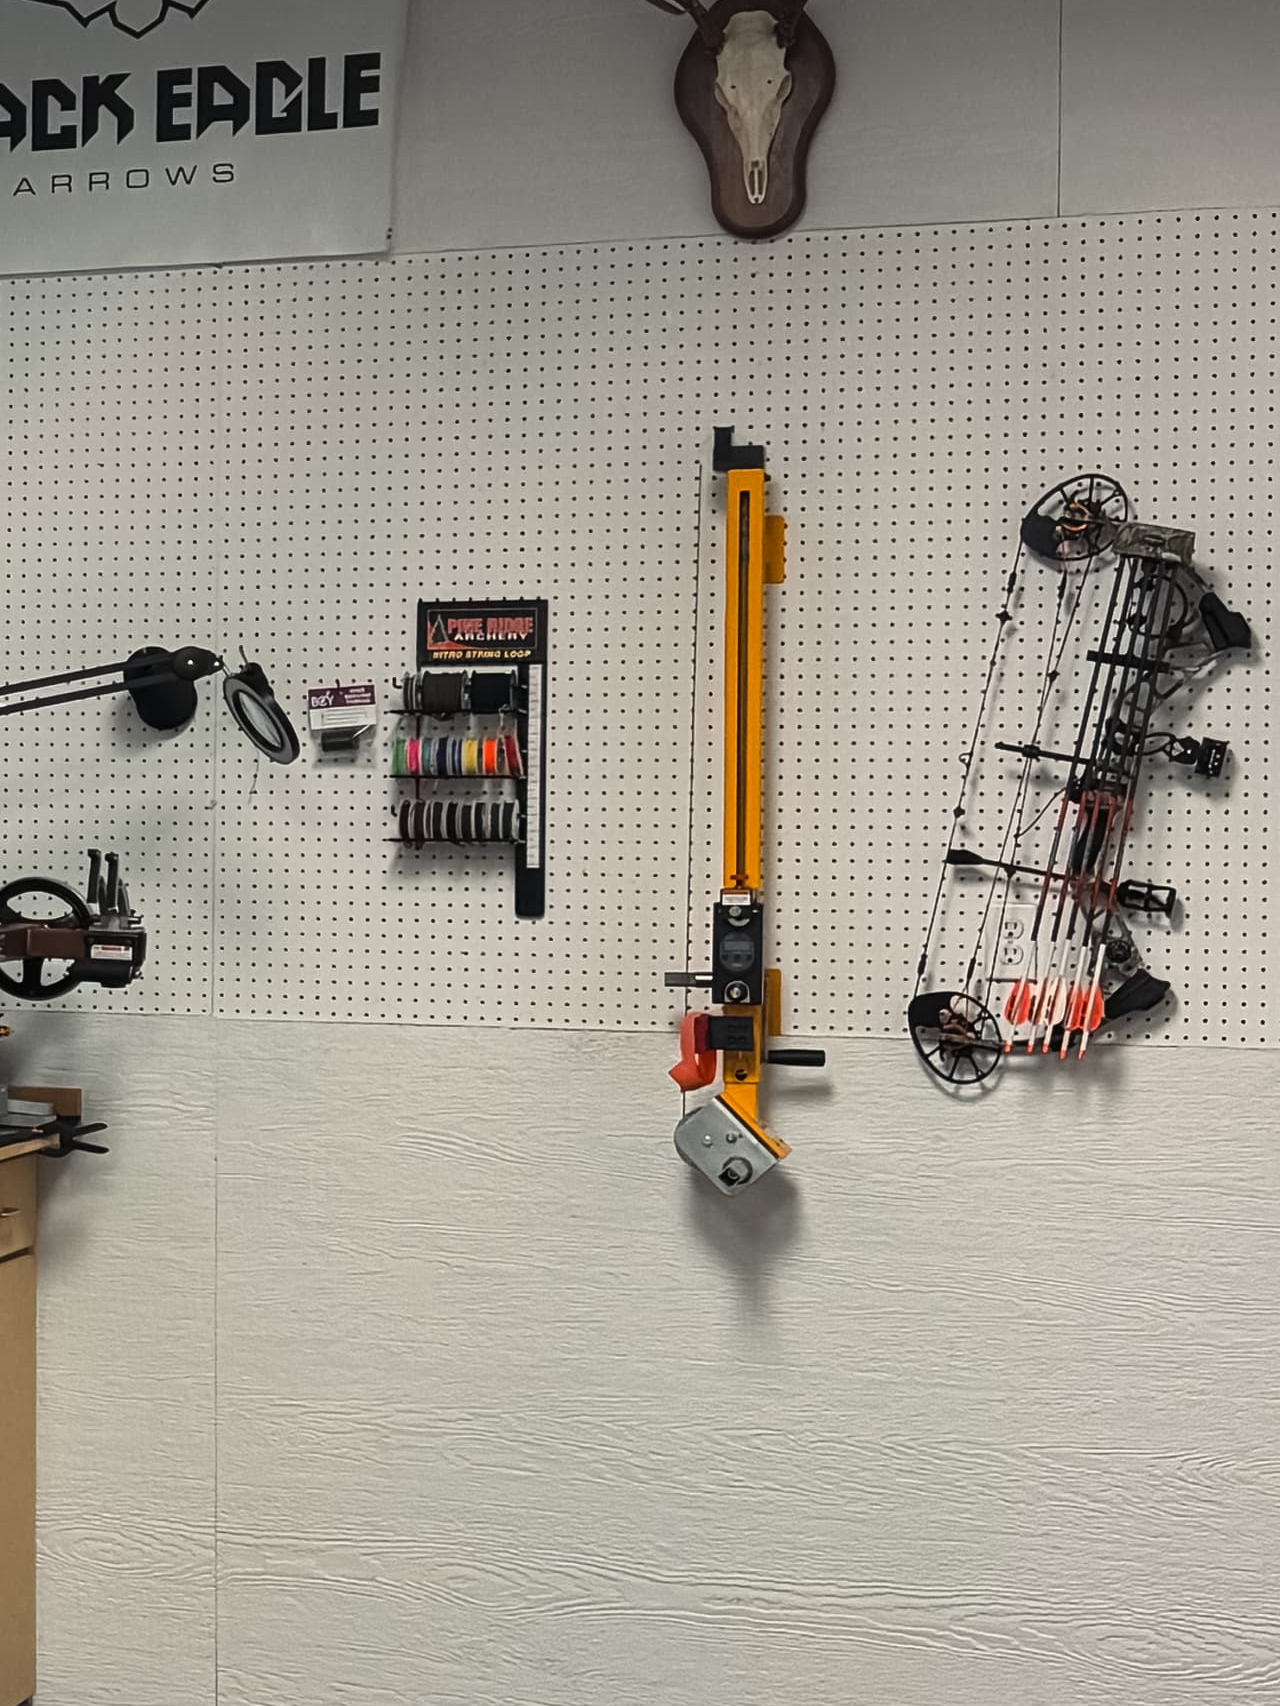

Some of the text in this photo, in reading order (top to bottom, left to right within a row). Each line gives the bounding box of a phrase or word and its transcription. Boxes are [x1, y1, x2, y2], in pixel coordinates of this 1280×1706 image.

[155, 51, 381, 143] EAGLE
[12, 162, 236, 198] ARROWS
[453, 631, 528, 641] ARCHERY
[504, 650, 531, 659] LOOP
